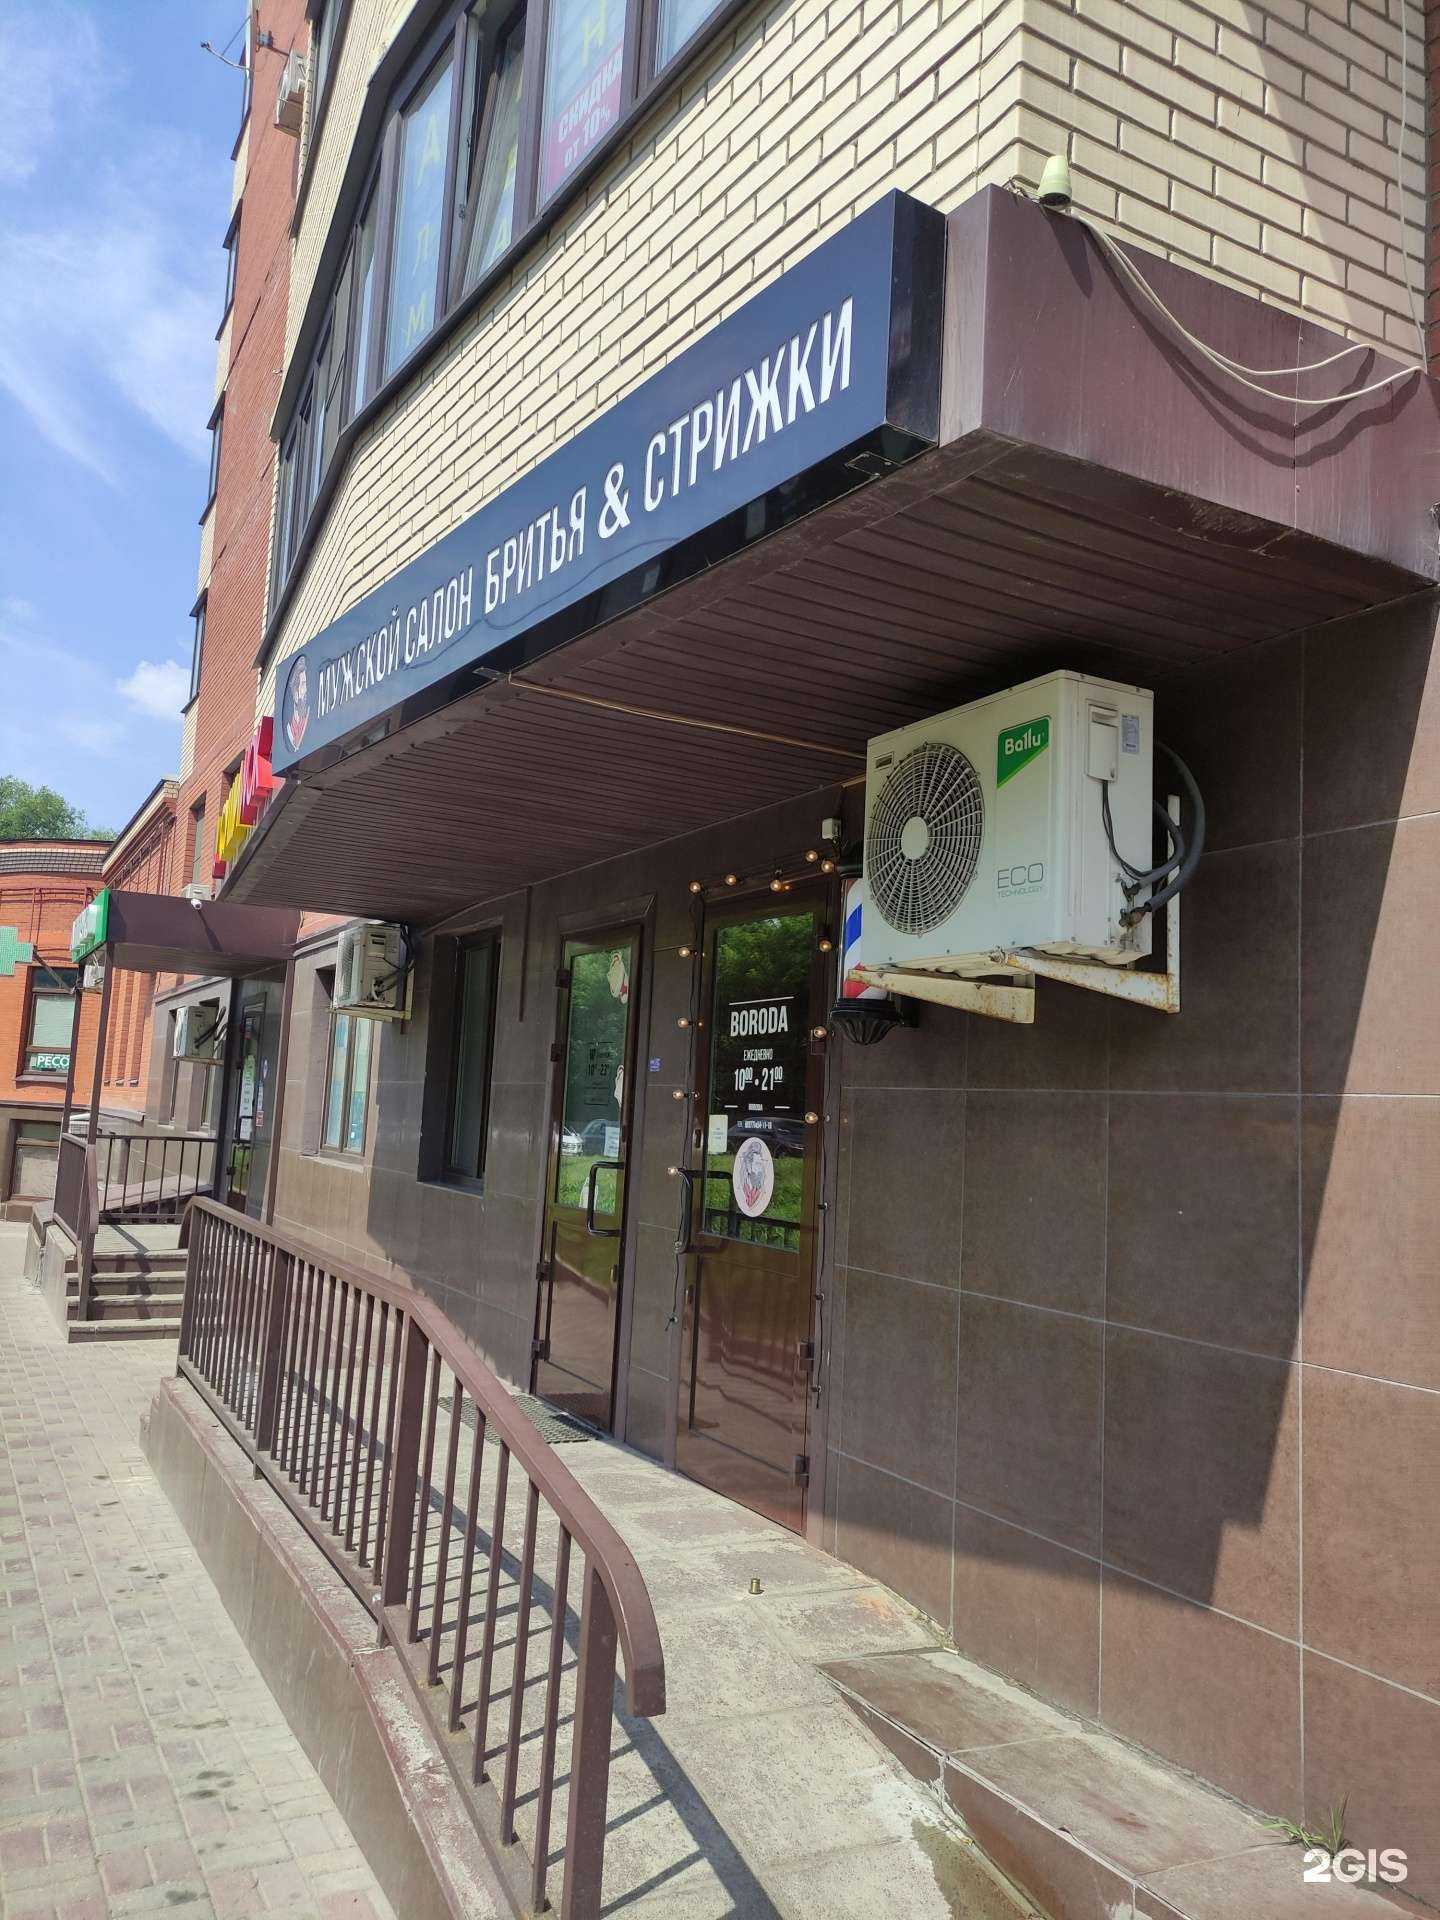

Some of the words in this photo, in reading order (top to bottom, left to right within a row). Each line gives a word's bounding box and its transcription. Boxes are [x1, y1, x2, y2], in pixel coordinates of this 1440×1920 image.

[317, 605, 400, 719] МУЖСКОЙ
[404, 566, 473, 664] САЛОН
[485, 486, 587, 615] БРИТЬЯ
[598, 462, 631, 539] &
[644, 297, 853, 513] СТРИЖКИ
[1004, 728, 1042, 756] Ballu
[997, 862, 1044, 889] ECO
[730, 1005, 789, 1037] BORODA
